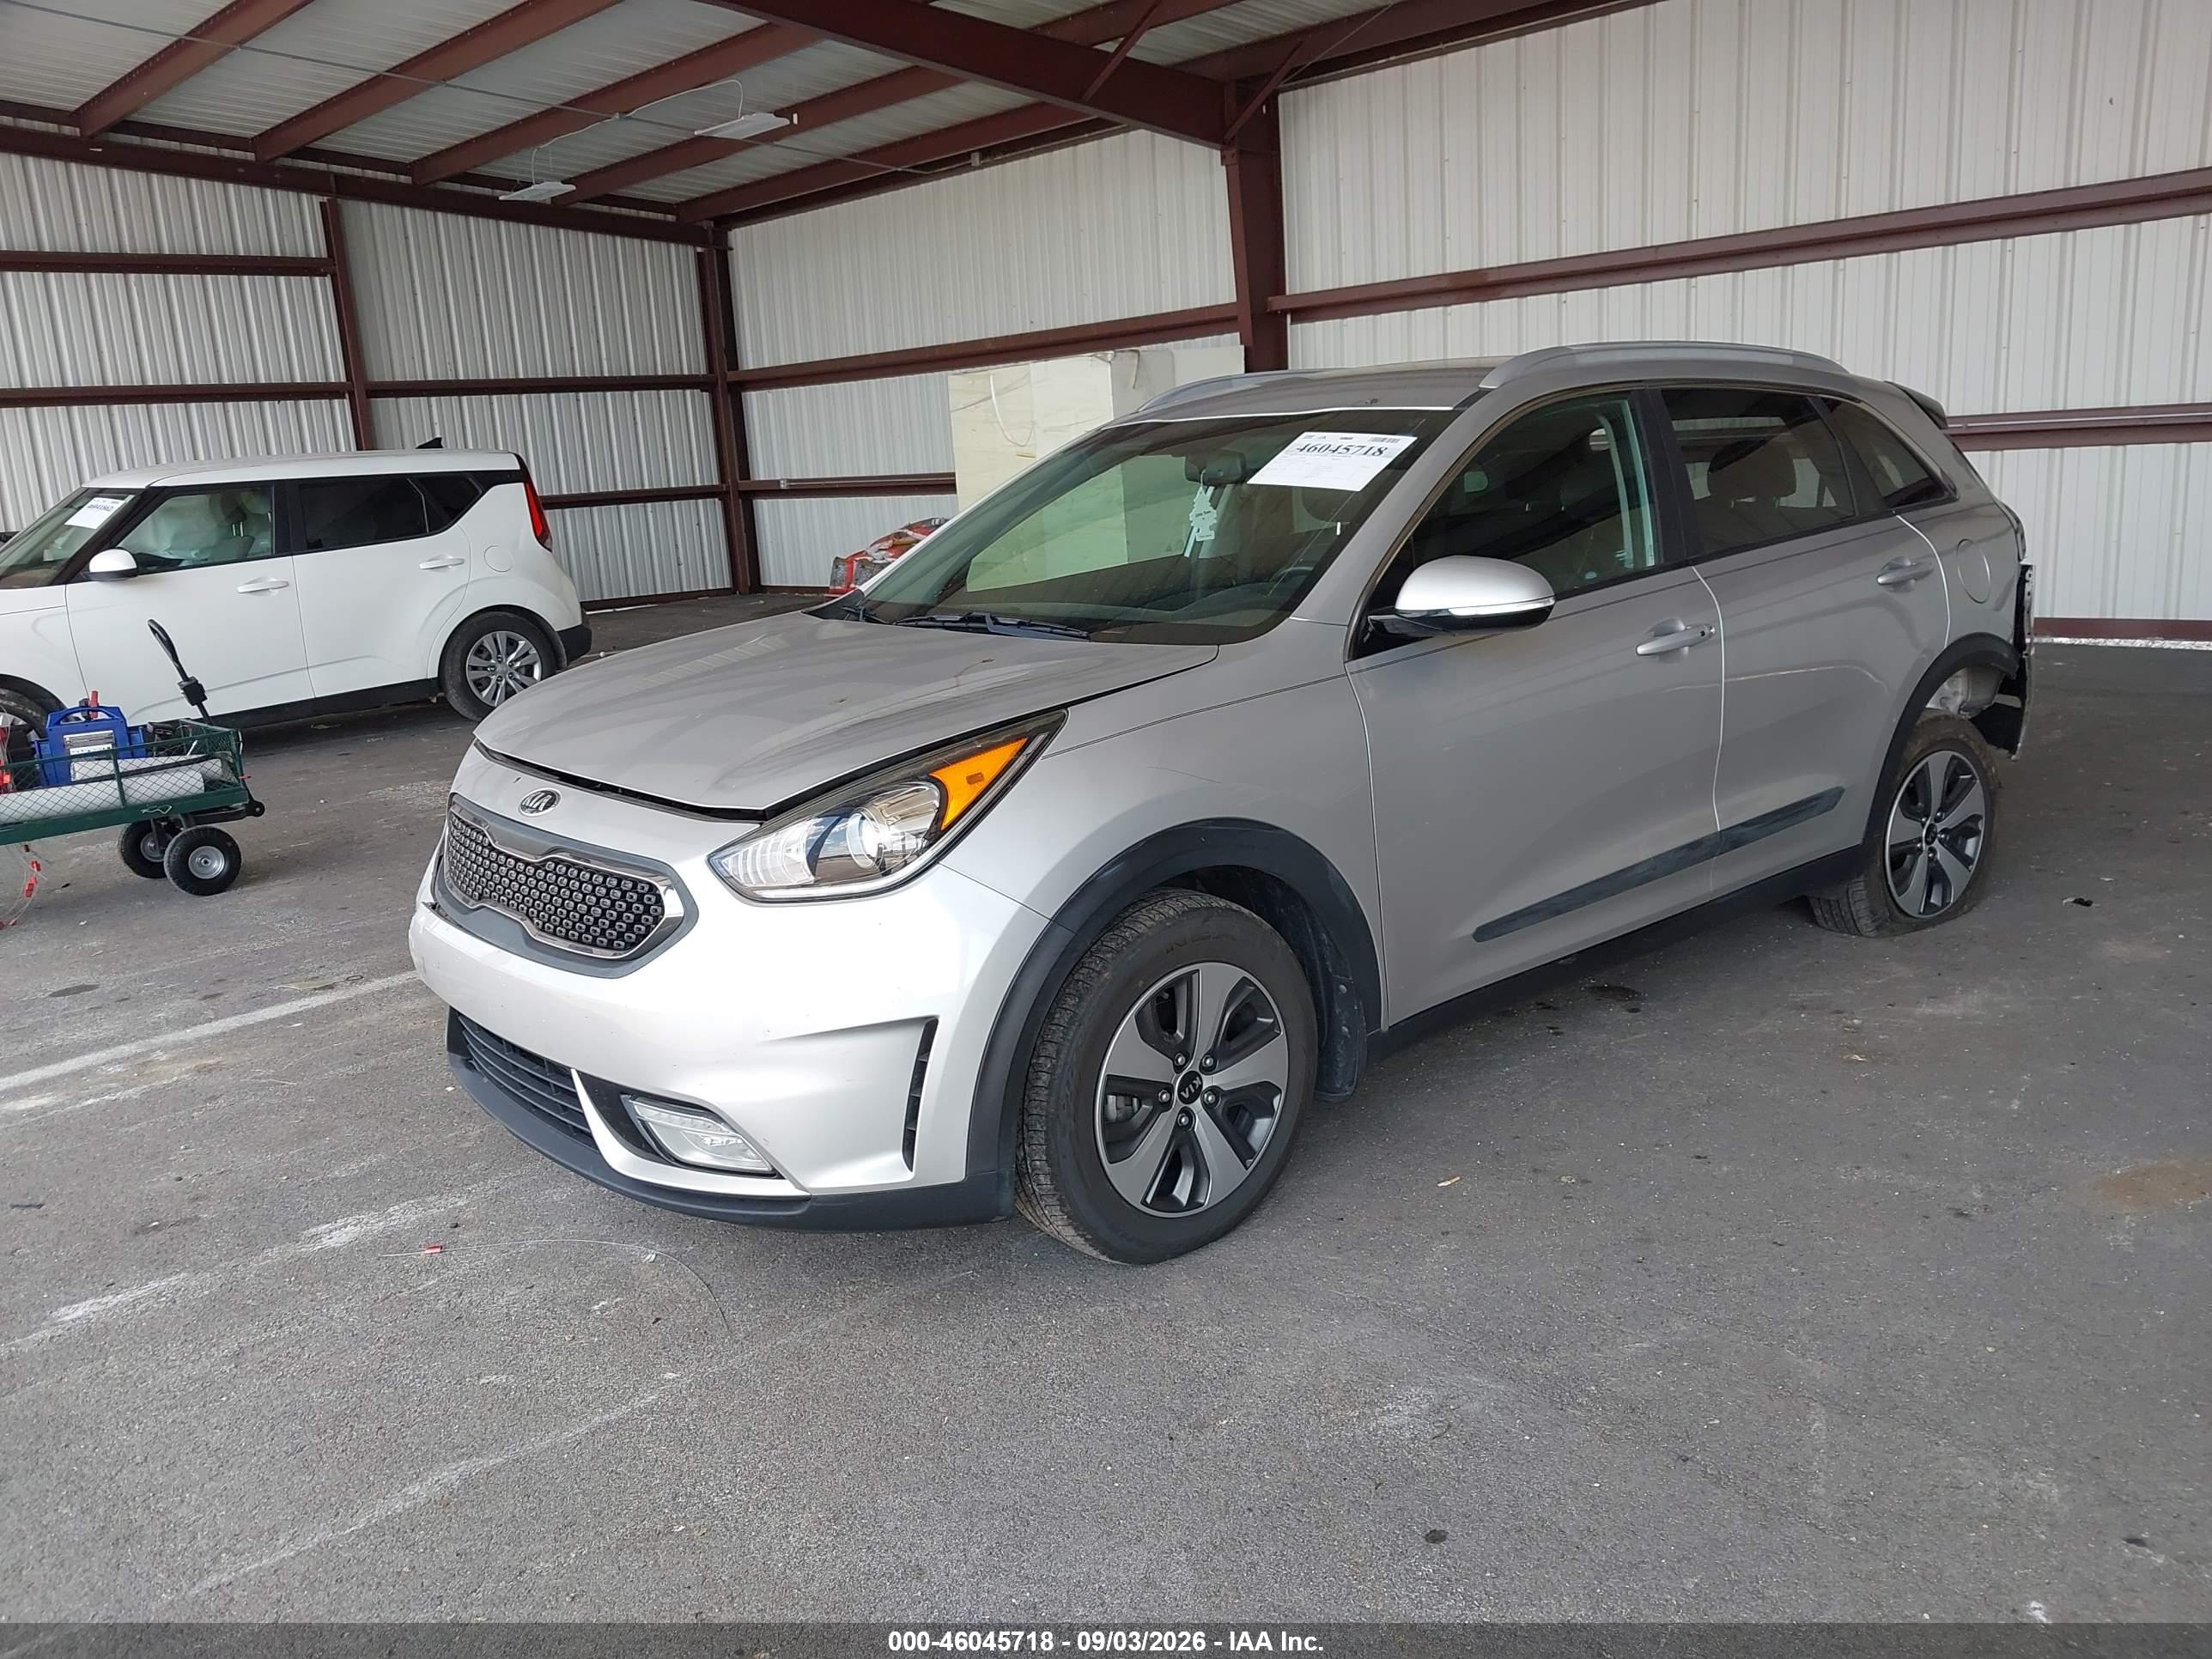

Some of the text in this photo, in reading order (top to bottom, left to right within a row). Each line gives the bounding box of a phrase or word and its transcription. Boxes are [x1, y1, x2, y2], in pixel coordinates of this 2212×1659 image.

[1296, 443, 1389, 457] 46045718
[521, 791, 552, 811] KIA
[1180, 1076, 1202, 1099] KIA
